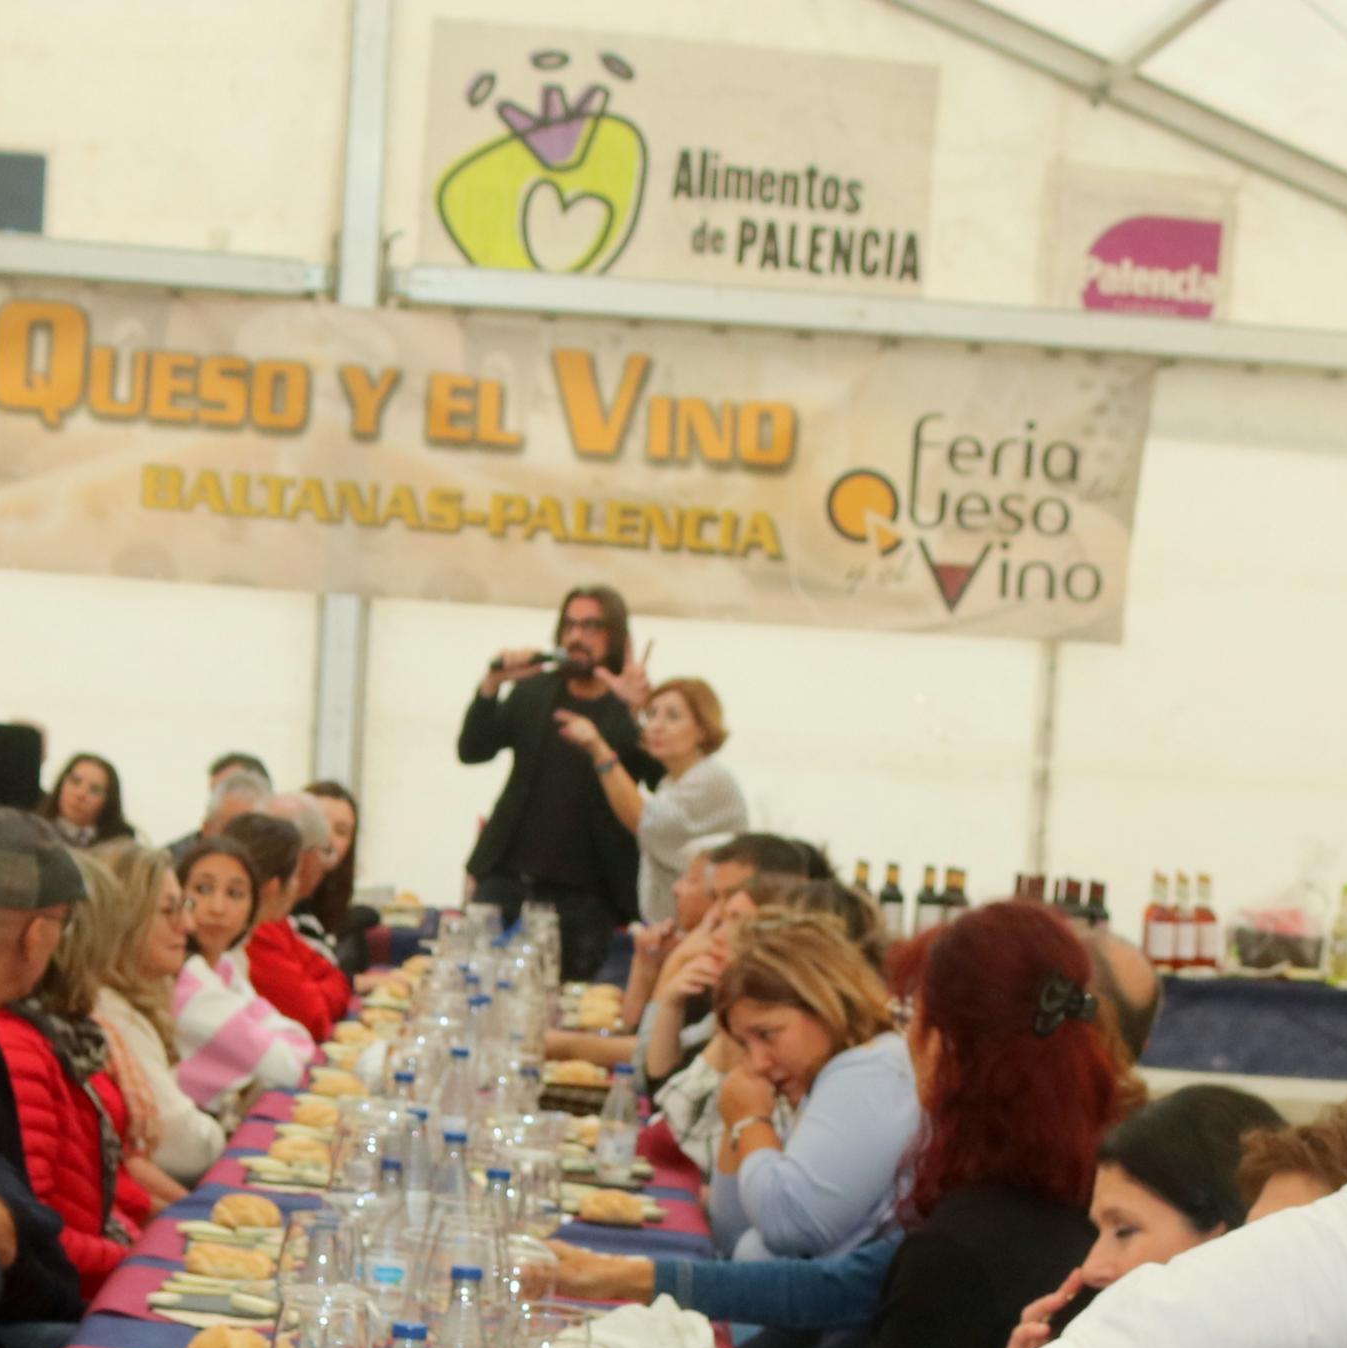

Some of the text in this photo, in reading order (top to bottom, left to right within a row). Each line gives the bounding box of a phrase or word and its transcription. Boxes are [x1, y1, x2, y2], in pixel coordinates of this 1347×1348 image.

[672, 147, 864, 214] Alimentos
[692, 217, 921, 283] de PALENCIA
[337, 363, 400, 441] Y
[425, 371, 524, 452] EL
[911, 411, 1080, 484] feria
[140, 463, 786, 560] BALTANAS-PALENCIA
